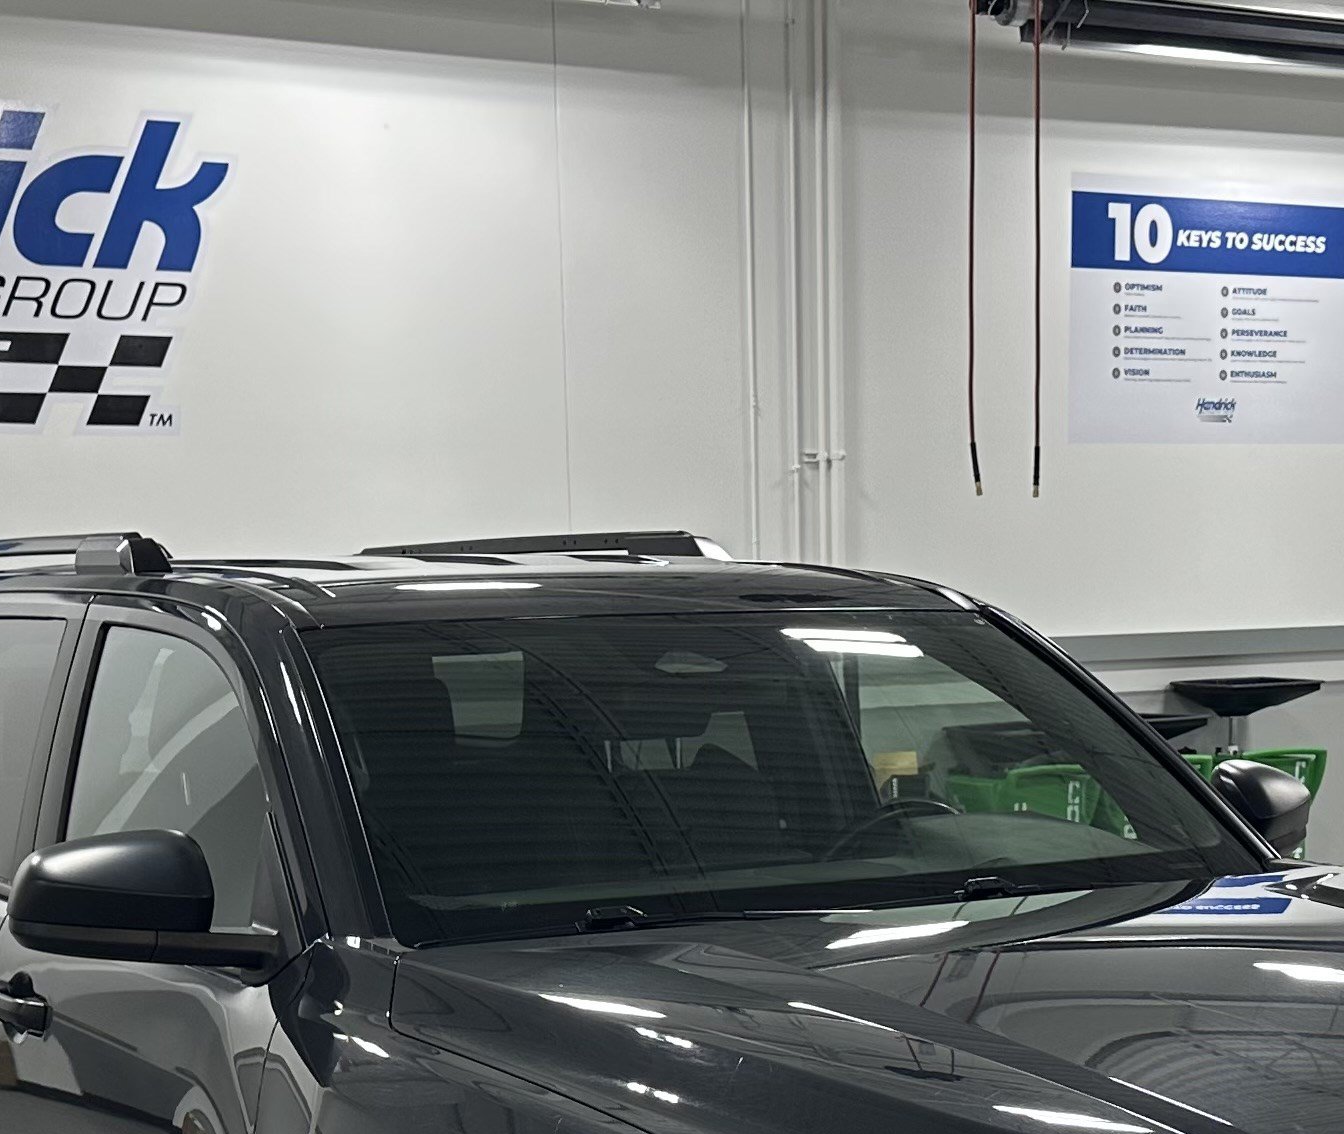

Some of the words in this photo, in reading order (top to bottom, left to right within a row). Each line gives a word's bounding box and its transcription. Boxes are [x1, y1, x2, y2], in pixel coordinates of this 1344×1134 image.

[1108, 201, 1173, 264] 10
[1176, 229, 1222, 249] KEYS
[1224, 231, 1249, 250] TO
[1251, 233, 1327, 254] SUCCESS
[1124, 282, 1163, 292] OPTIMISM
[1232, 287, 1268, 296] ATTITUDE
[1124, 304, 1147, 313] FAITH
[1231, 308, 1256, 316] GOALS
[1124, 325, 1164, 335] PLANNING
[1231, 328, 1288, 338] PERSEVERANCE
[1123, 346, 1186, 356] DETERMINATION
[1230, 350, 1278, 359] KNOWLEDGE
[1123, 368, 1150, 377] VISION
[1230, 370, 1277, 379] ENTHUSIASM
[147, 411, 175, 427] TM
